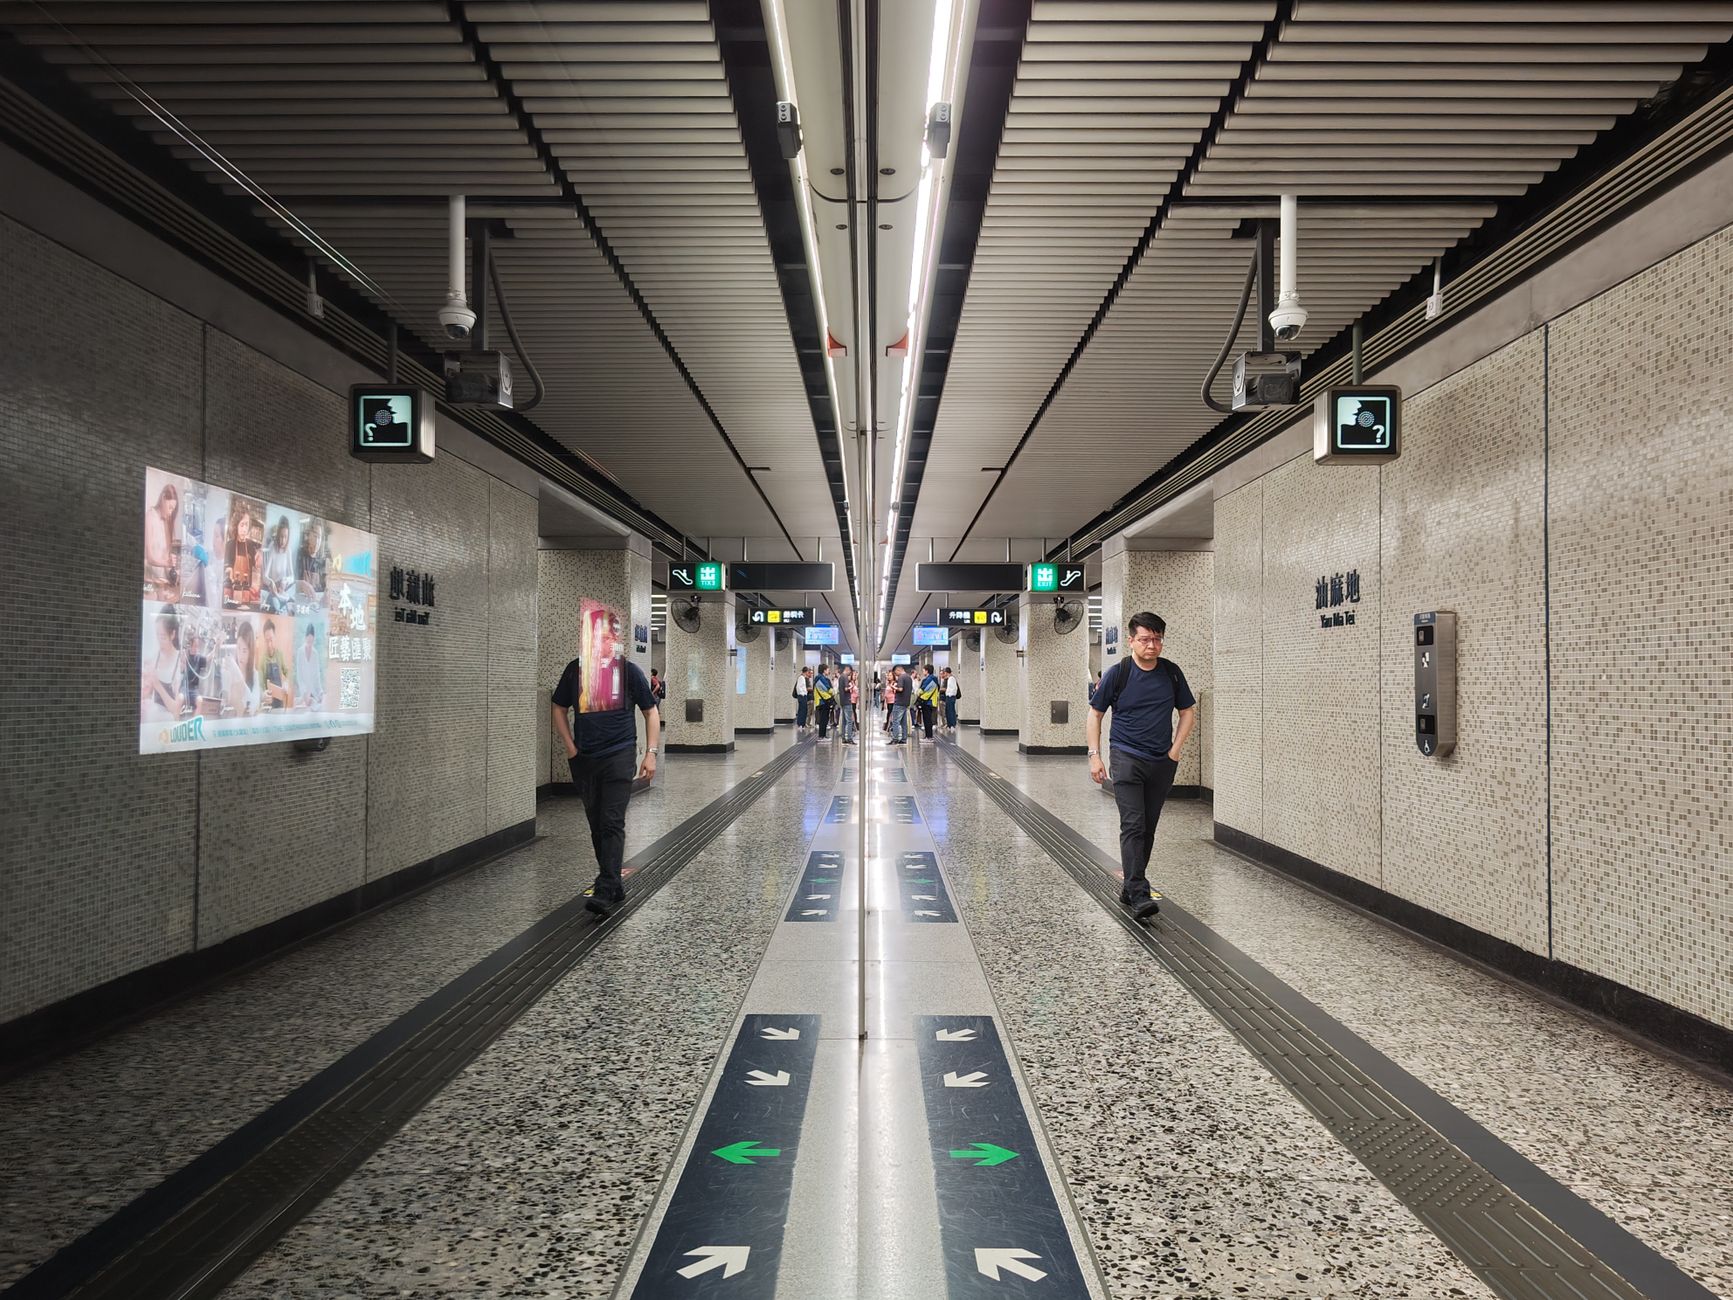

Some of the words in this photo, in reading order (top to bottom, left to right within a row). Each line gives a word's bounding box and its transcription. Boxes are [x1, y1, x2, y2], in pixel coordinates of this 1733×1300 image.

[1037, 567, 1053, 581] 出
[1315, 569, 1361, 609] 油麻地
[1320, 614, 1332, 628] Yau
[1344, 610, 1355, 625] Tai
[169, 715, 206, 743] LOUDER
